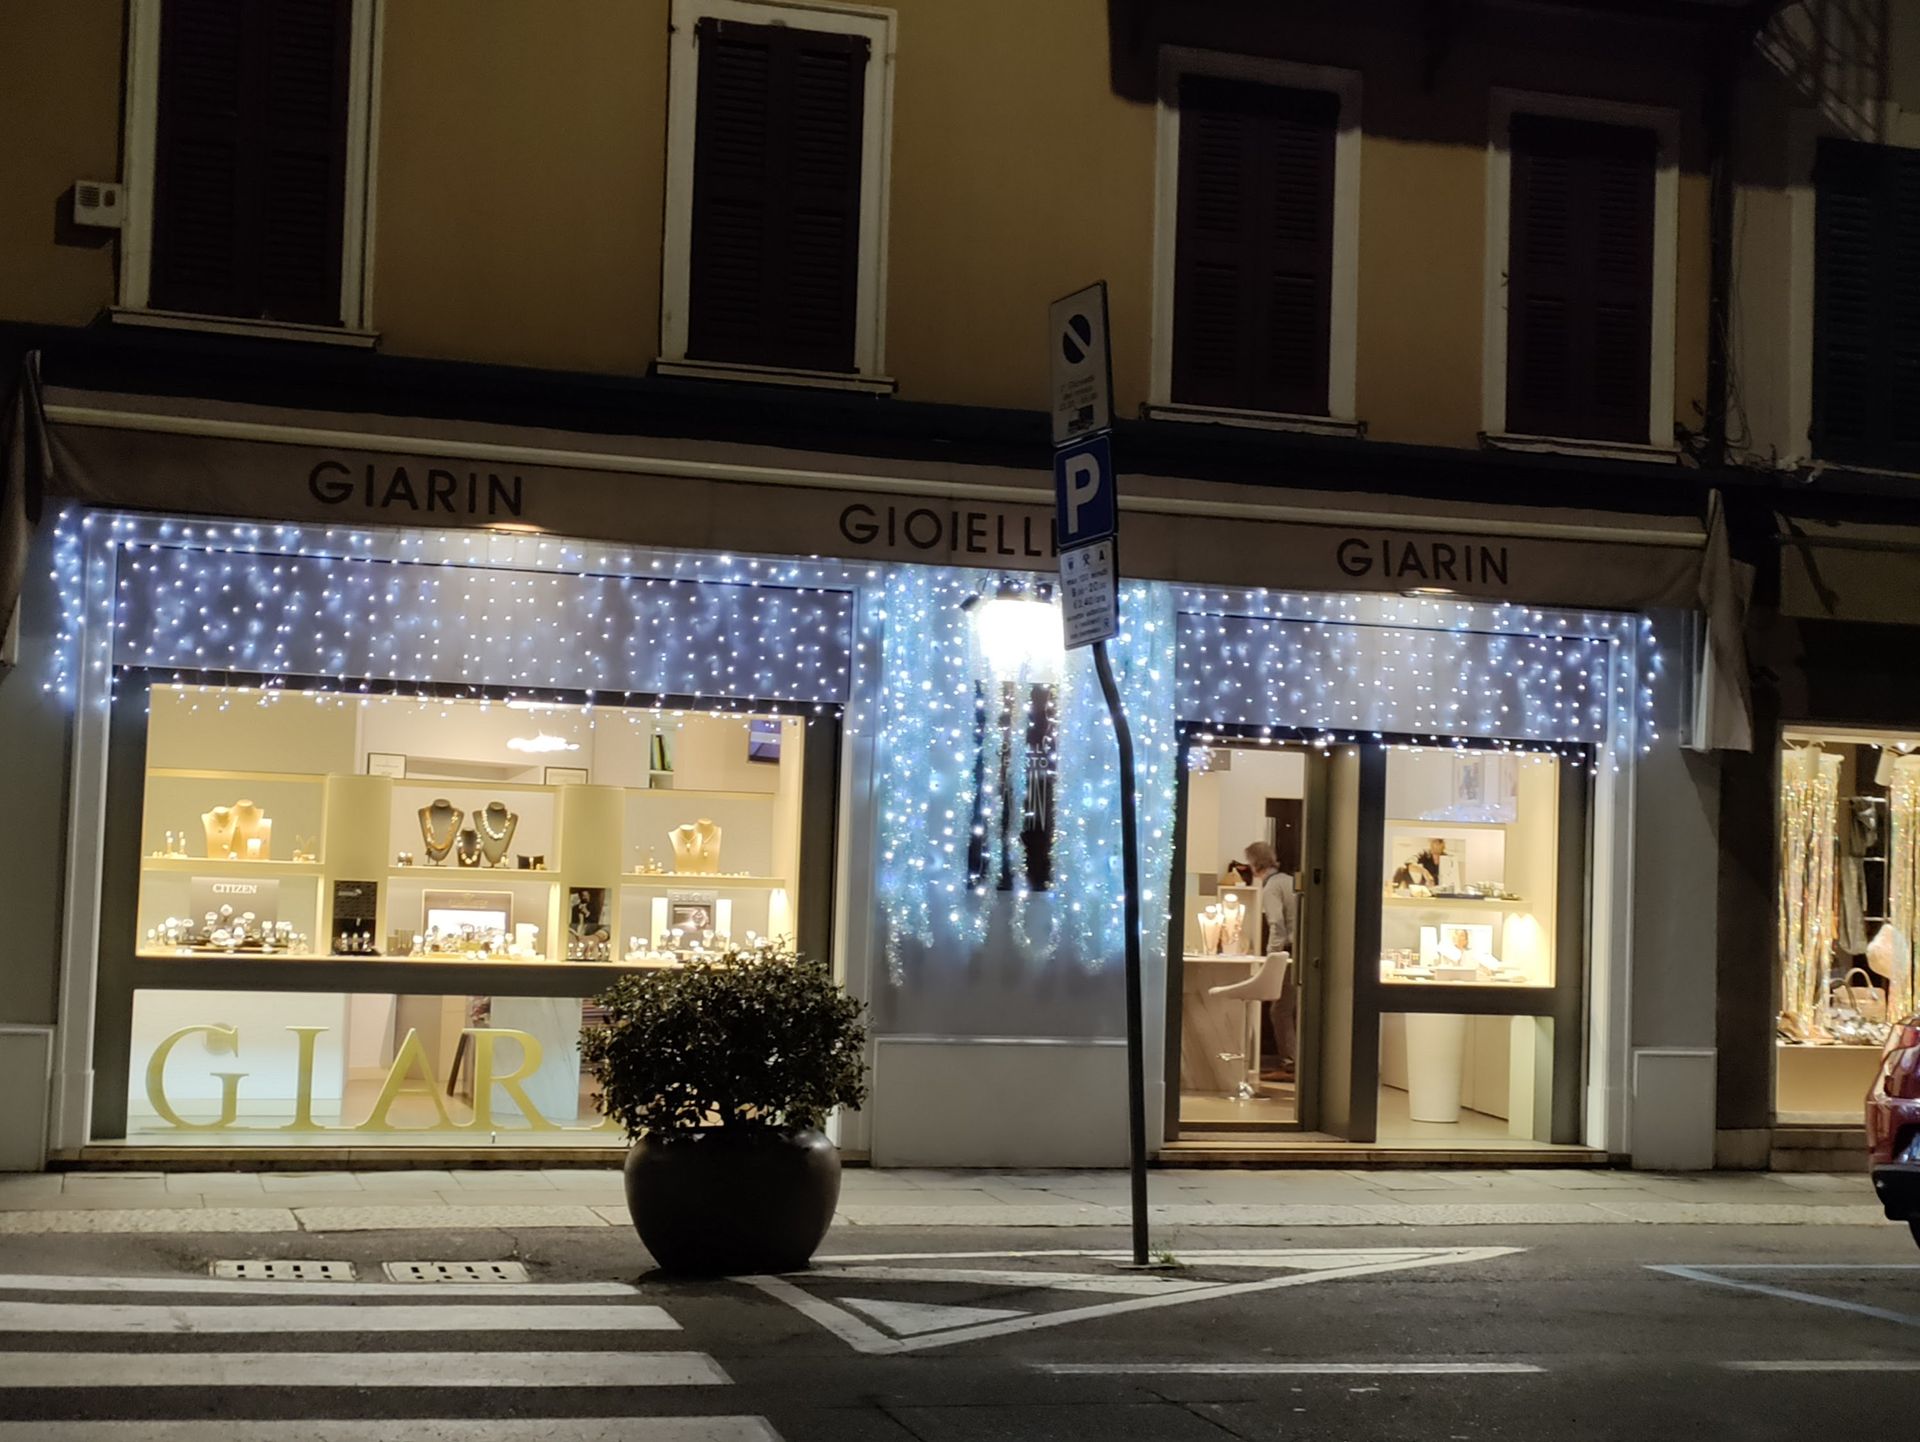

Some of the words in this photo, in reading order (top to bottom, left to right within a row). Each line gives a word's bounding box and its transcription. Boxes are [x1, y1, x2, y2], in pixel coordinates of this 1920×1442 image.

[308, 460, 522, 517] GIARIN
[1065, 452, 1100, 534] P
[1336, 537, 1508, 585] GIARIN
[212, 883, 257, 894] CITIZEN
[145, 1023, 622, 1133] GIAR
